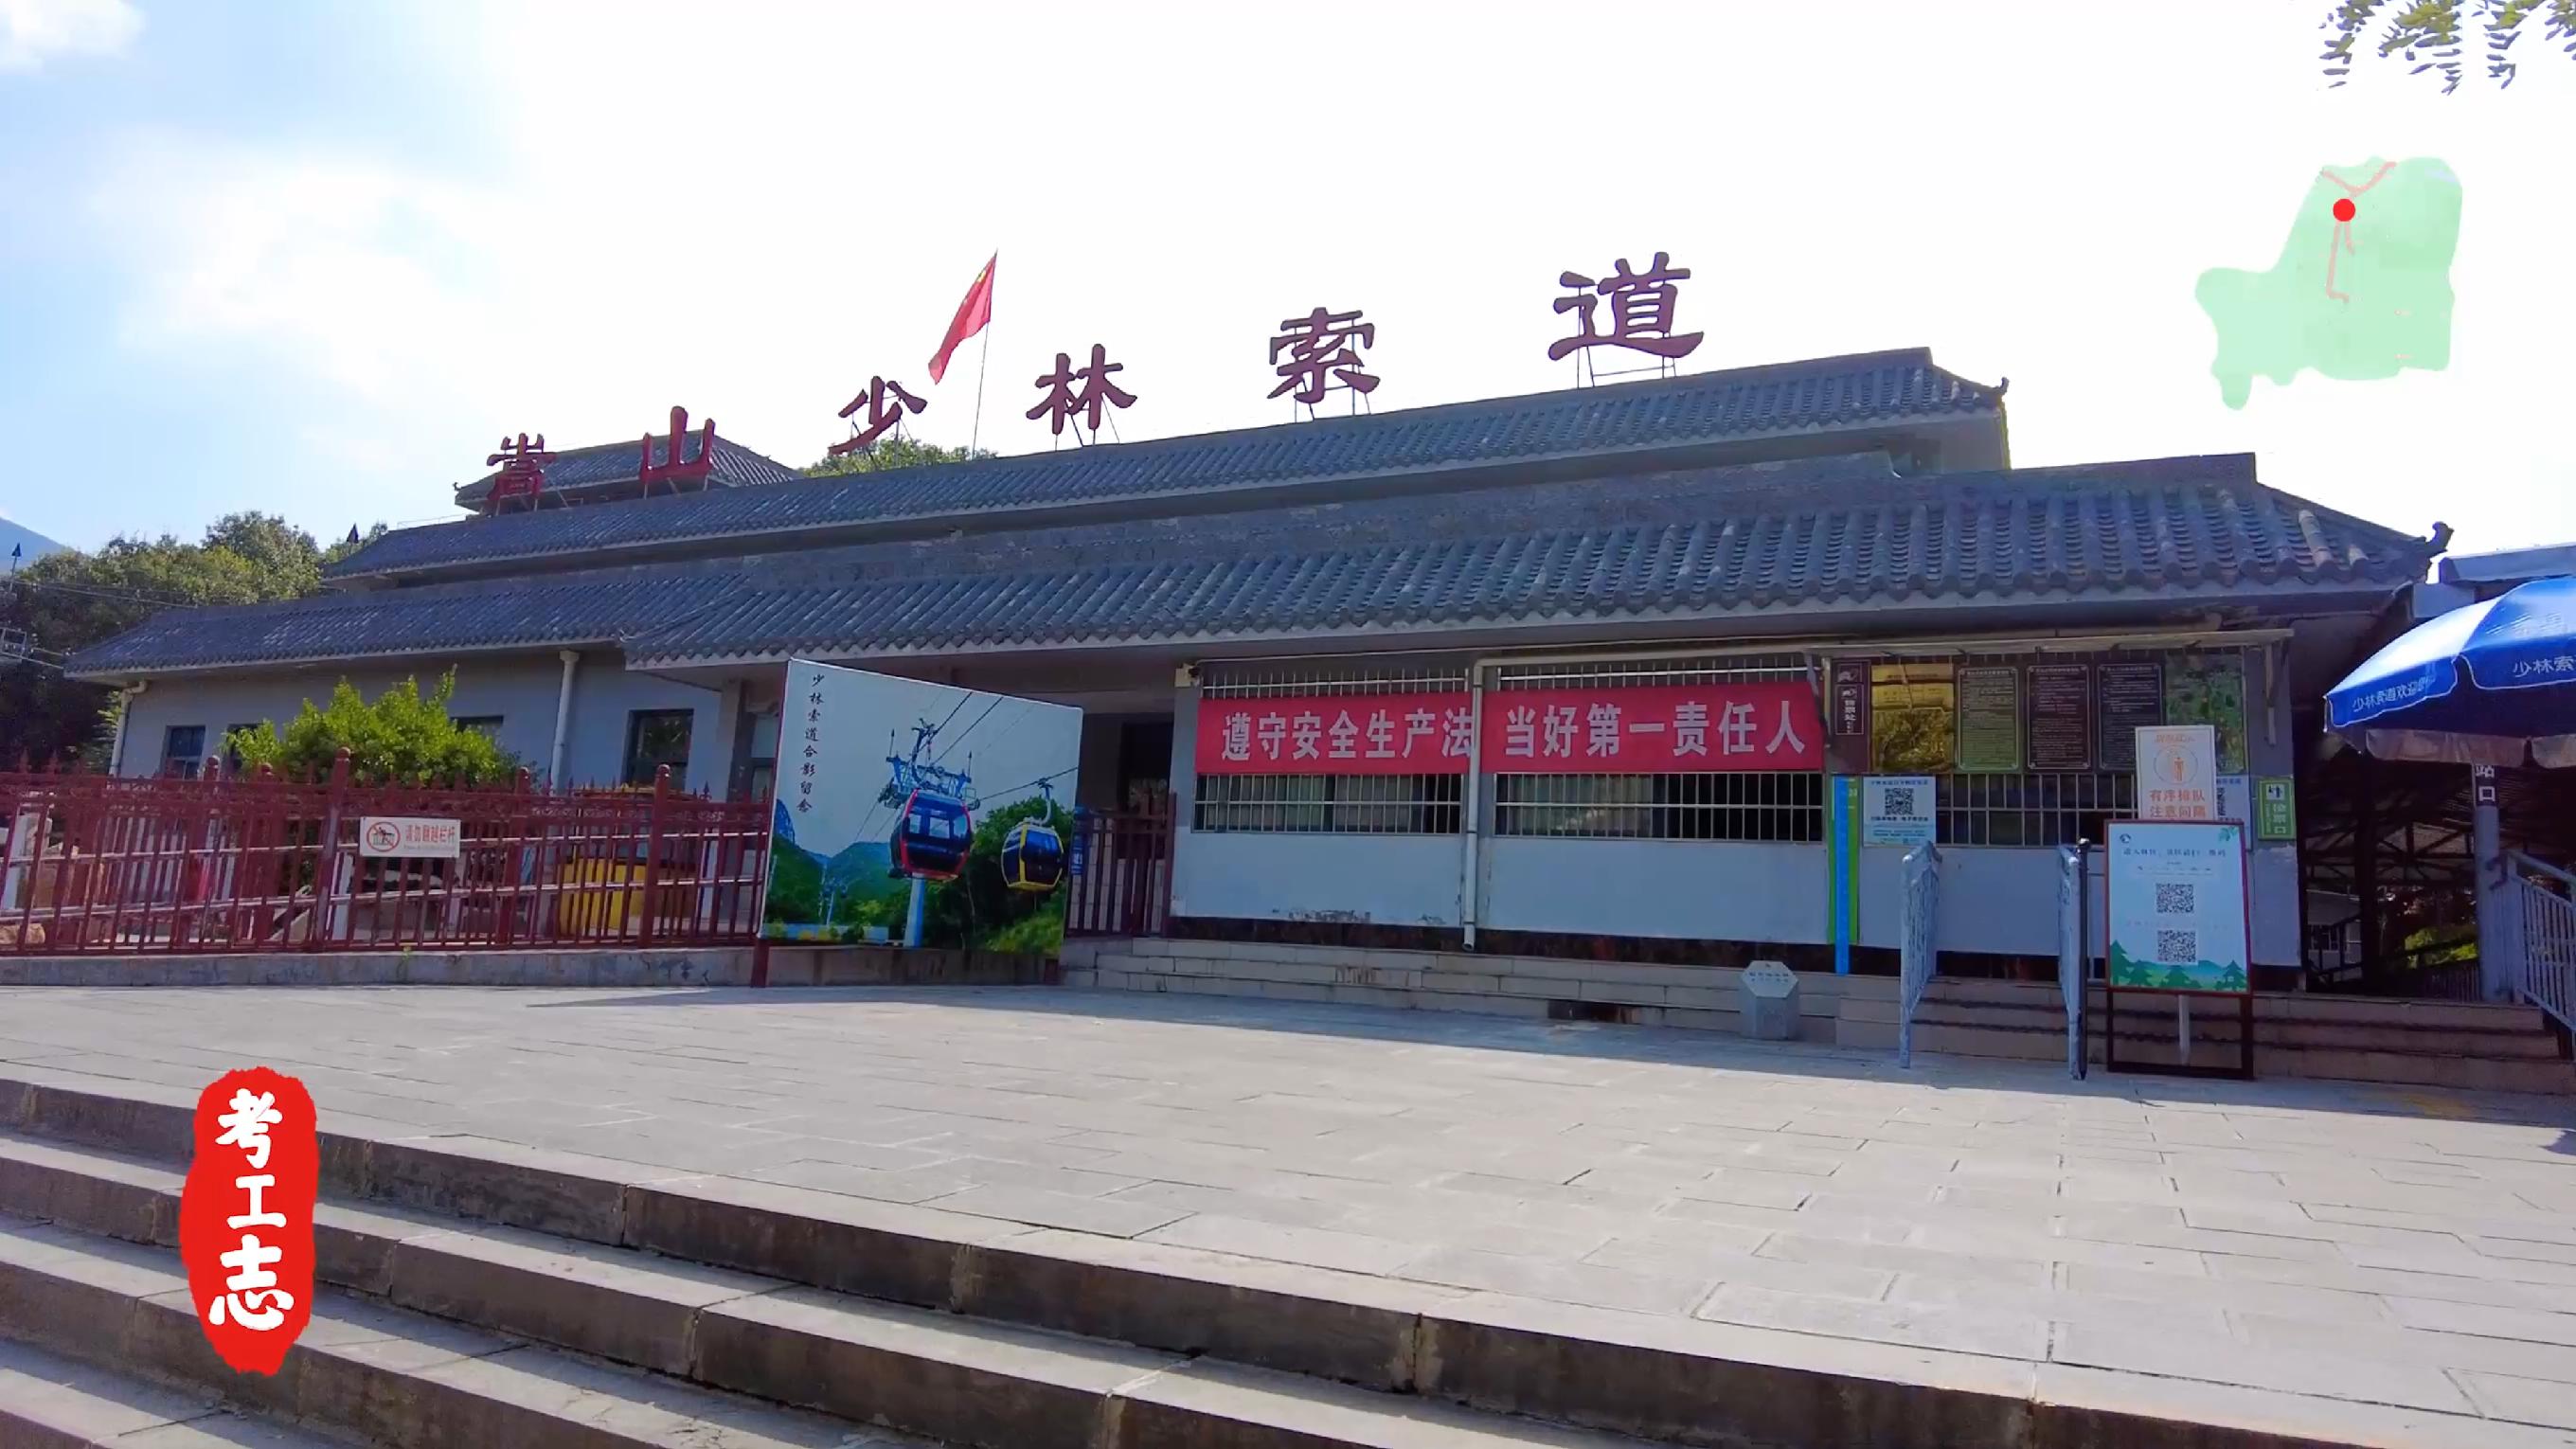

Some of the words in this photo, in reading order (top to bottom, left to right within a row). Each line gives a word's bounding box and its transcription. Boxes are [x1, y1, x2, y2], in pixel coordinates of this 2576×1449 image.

[485, 252, 1704, 508] 嵩山少林索道
[2513, 655, 2576, 678] 少林索
[796, 673, 825, 813] 少林索道合影留念
[1222, 707, 1472, 760] 遵守安全生产法
[1506, 699, 1805, 758] 当好第一责任人
[2150, 789, 2205, 802] 有序排队
